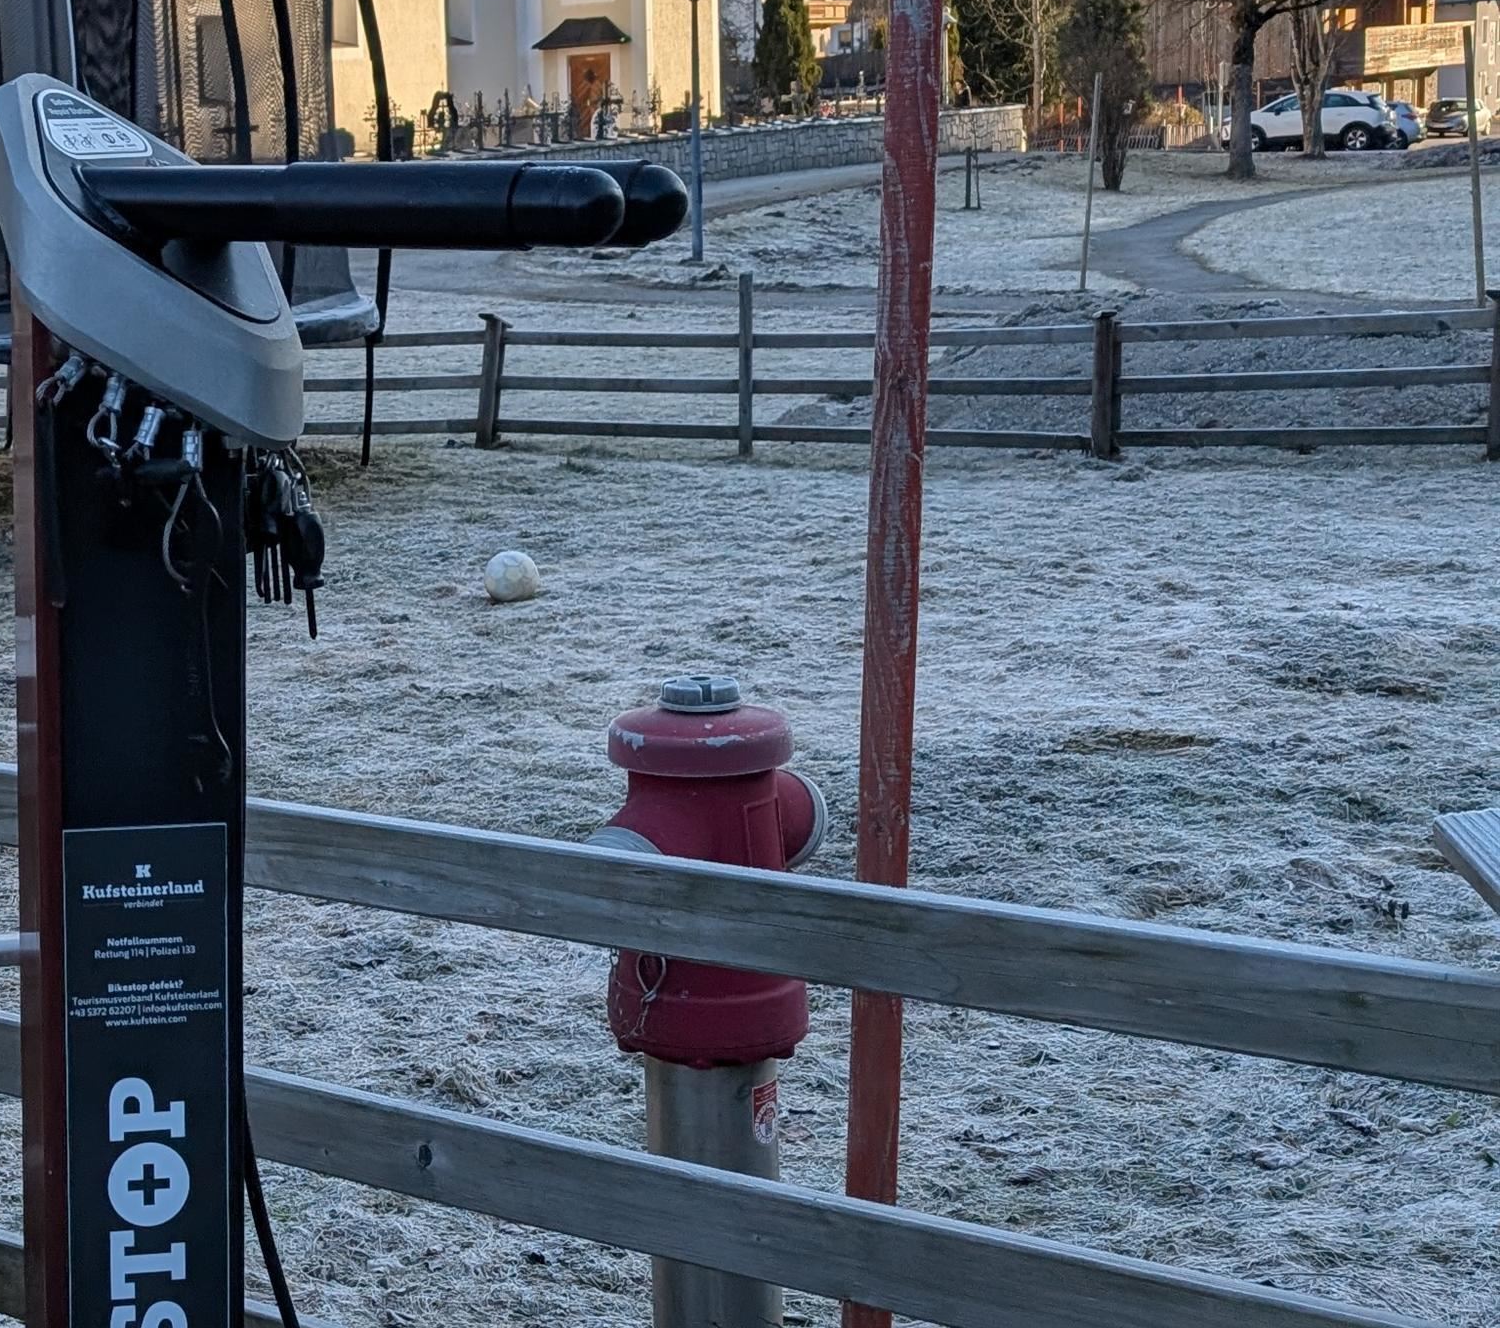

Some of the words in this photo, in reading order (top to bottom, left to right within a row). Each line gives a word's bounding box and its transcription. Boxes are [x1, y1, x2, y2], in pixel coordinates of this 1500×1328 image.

[82, 880, 205, 899] Kufsteinerland
[123, 899, 164, 909] verbindet
[107, 936, 183, 947] Notfallnummern
[94, 949, 130, 959] Rettung
[150, 946, 181, 956] Polizei
[182, 945, 196, 954] 133
[107, 983, 148, 993] Bikestop
[149, 980, 184, 990] defekt?
[72, 993, 153, 1006] Tourismusverband
[154, 989, 220, 1001] Kufsteinerland
[87, 1007, 107, 1016] 5372
[109, 1005, 136, 1016] 62207
[142, 1001, 223, 1013] info@kufstein.com
[105, 1015, 187, 1027] www.kufstein.com
